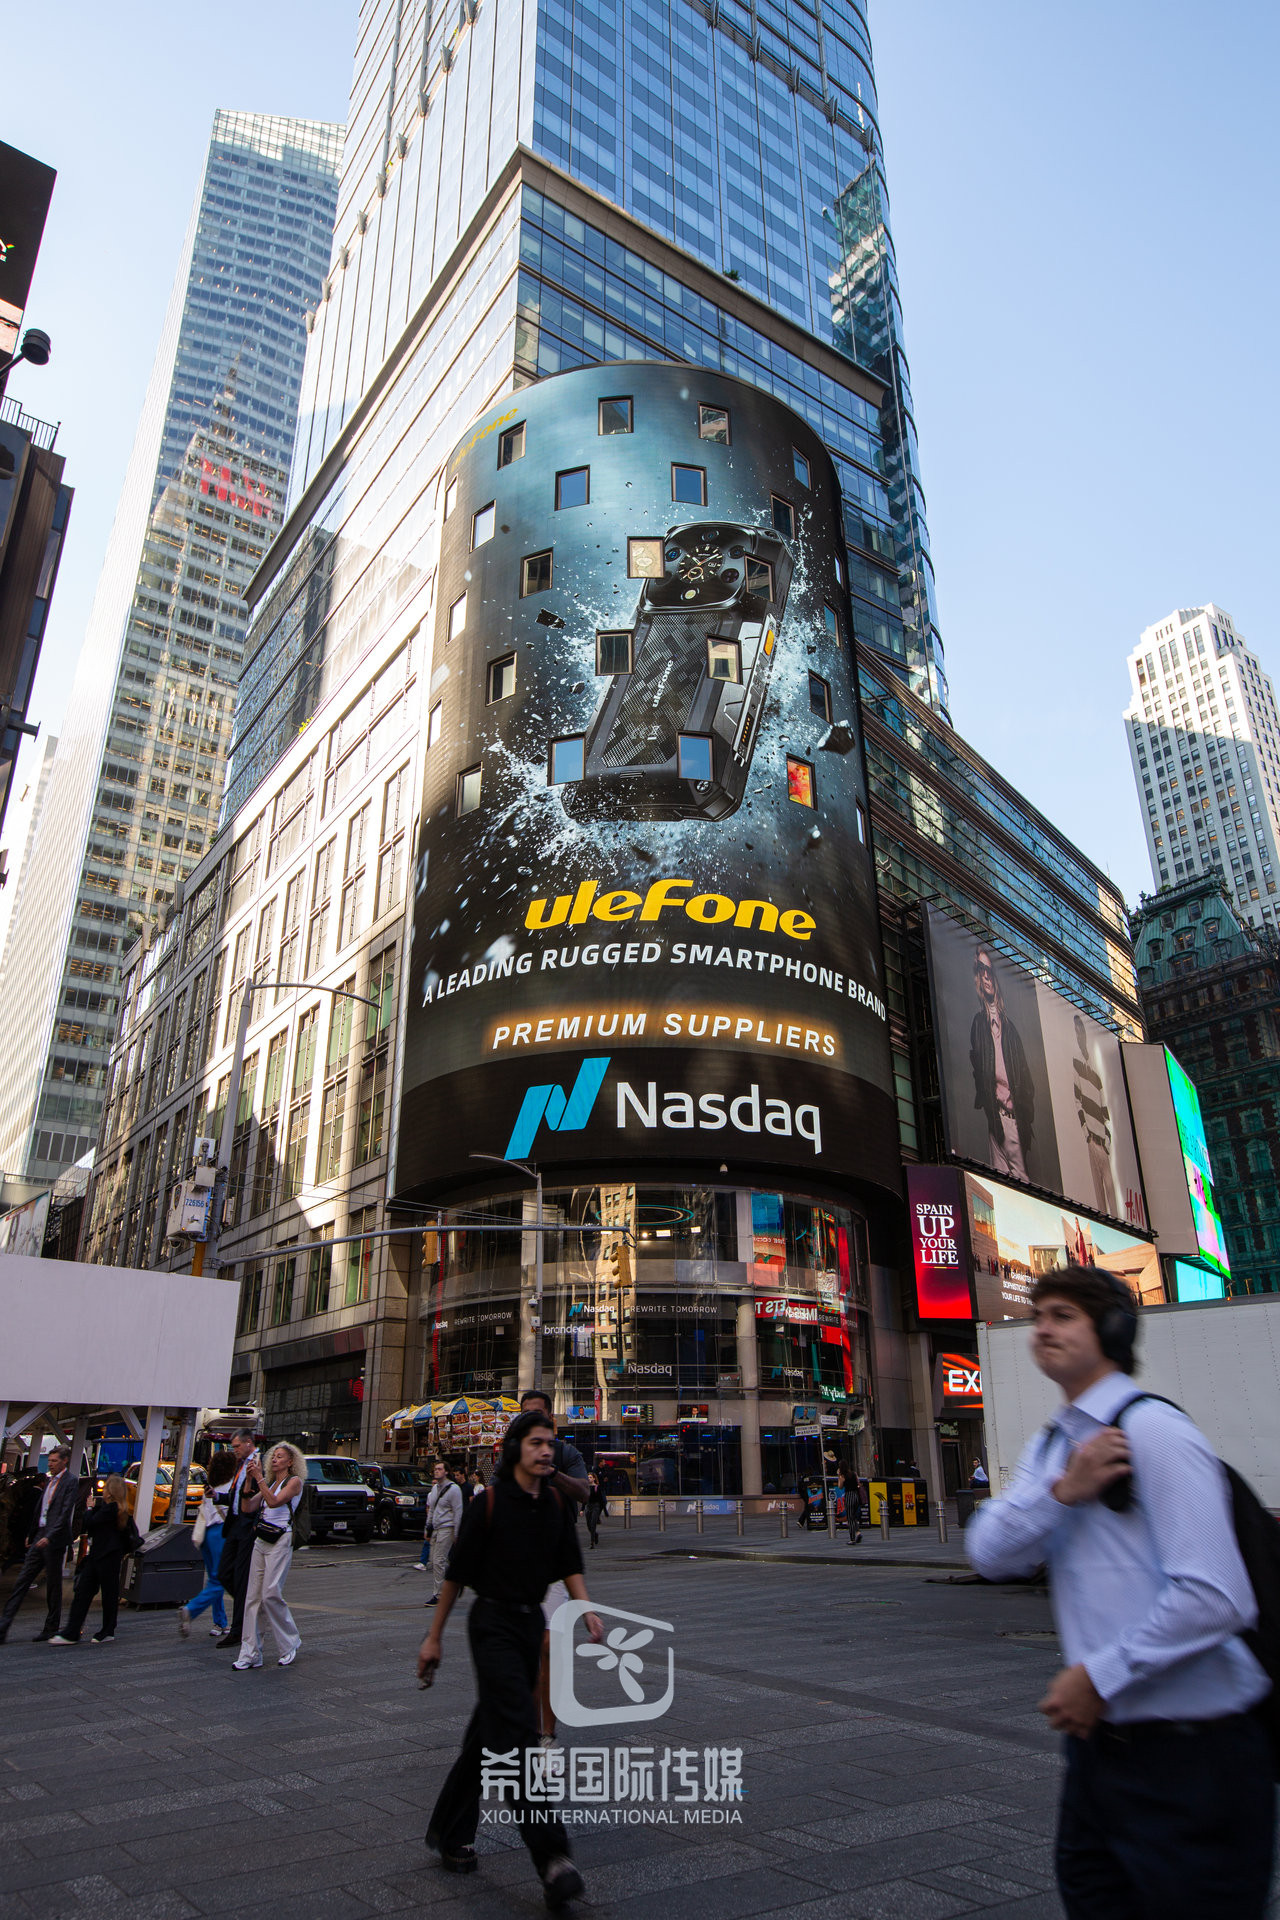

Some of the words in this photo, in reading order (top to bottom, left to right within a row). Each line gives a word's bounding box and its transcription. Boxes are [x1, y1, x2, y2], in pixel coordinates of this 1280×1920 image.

[422, 986, 433, 1007] A
[437, 953, 533, 1000] LEADING
[541, 942, 662, 970] RUGGED
[670, 943, 844, 994] SMARTPHONE
[848, 977, 886, 1022] BRAND
[492, 1013, 647, 1049] PREMIUM
[664, 1013, 836, 1056] SUPPLIERS
[616, 1081, 822, 1155] Nasdaq
[916, 1203, 953, 1215] SPAIN
[917, 1215, 955, 1238] UP
[919, 1238, 958, 1250] YOUR
[920, 1249, 959, 1265] LIFE
[1001, 1291, 1013, 1301] YOUR
[1013, 1294, 1021, 1303] LIFE
[583, 1304, 615, 1314] Nasdaq
[631, 1305, 667, 1313] REWRITE
[671, 1305, 718, 1313] TOMORROW
[477, 1311, 513, 1322] TOMORROW
[544, 1323, 586, 1335] branded
[627, 1363, 673, 1376] Nasdaq
[948, 1369, 983, 1393] EX
